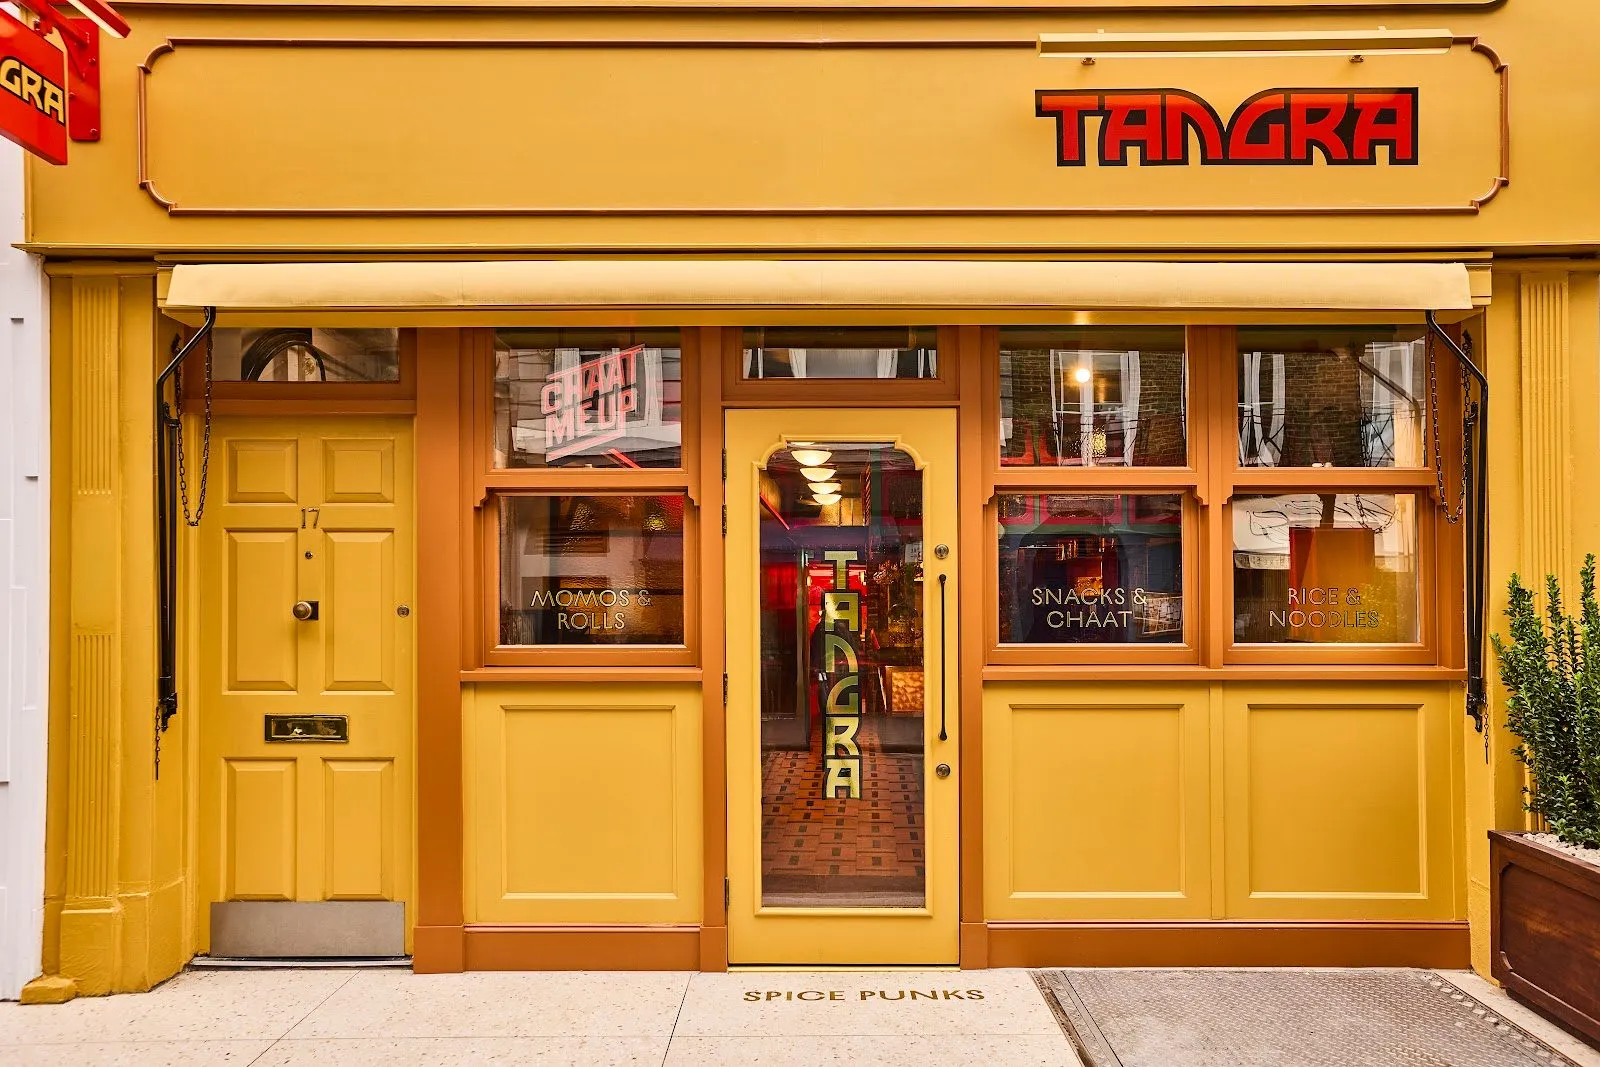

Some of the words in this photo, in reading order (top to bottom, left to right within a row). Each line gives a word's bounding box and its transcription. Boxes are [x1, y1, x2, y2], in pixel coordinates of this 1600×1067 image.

[1036, 87, 1418, 166] TANGRA
[541, 345, 645, 416] CHAAT
[301, 507, 320, 529] 17
[530, 589, 630, 607] MOMOS
[637, 589, 652, 607] &
[1031, 587, 1125, 606] SNACKS
[1133, 587, 1148, 605] &
[1288, 587, 1339, 606] RICE
[1345, 587, 1361, 605] &
[557, 612, 625, 630] ROLLS
[1046, 610, 1132, 629] CHAAT
[1269, 610, 1380, 628] NOODLES
[823, 550, 861, 799] TANGRA
[743, 990, 846, 1002] SPICE
[859, 989, 985, 1001] PUNKS
